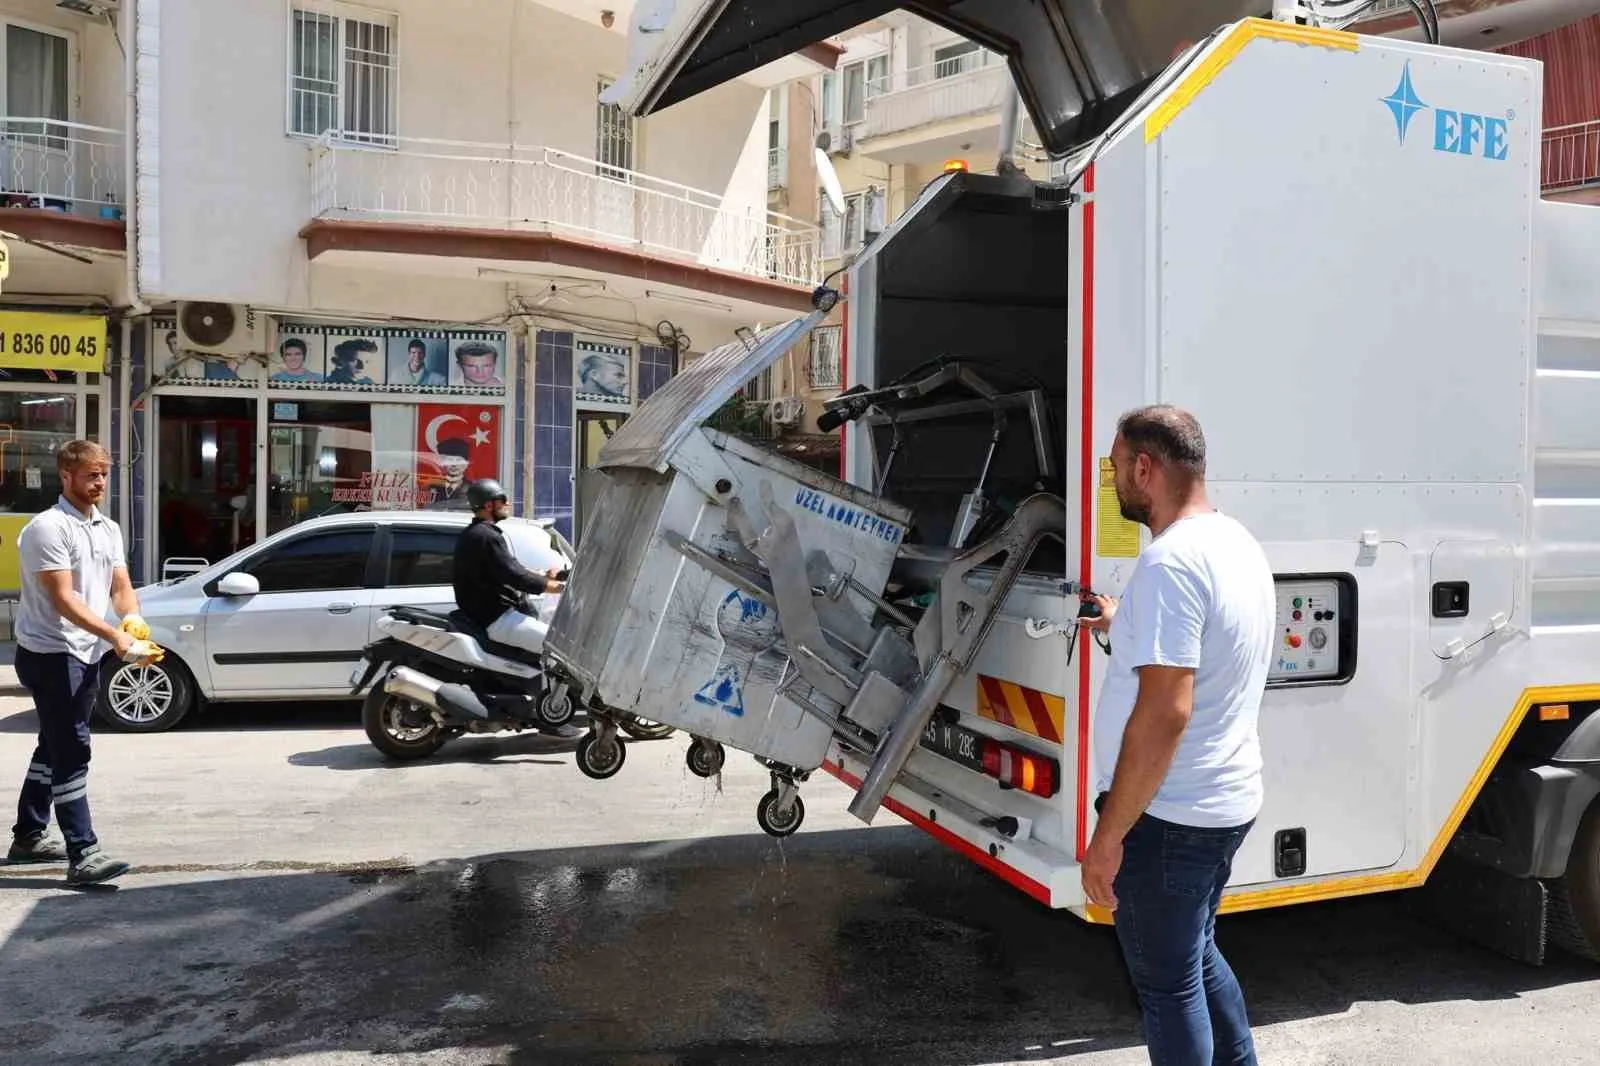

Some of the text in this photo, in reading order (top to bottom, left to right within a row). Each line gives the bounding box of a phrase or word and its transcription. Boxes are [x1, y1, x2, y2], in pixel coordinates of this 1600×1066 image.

[1433, 108, 1508, 161] EFE
[13, 333, 44, 354] 836
[50, 335, 70, 355] 00
[76, 336, 97, 356] 45
[944, 727, 951, 750] M
